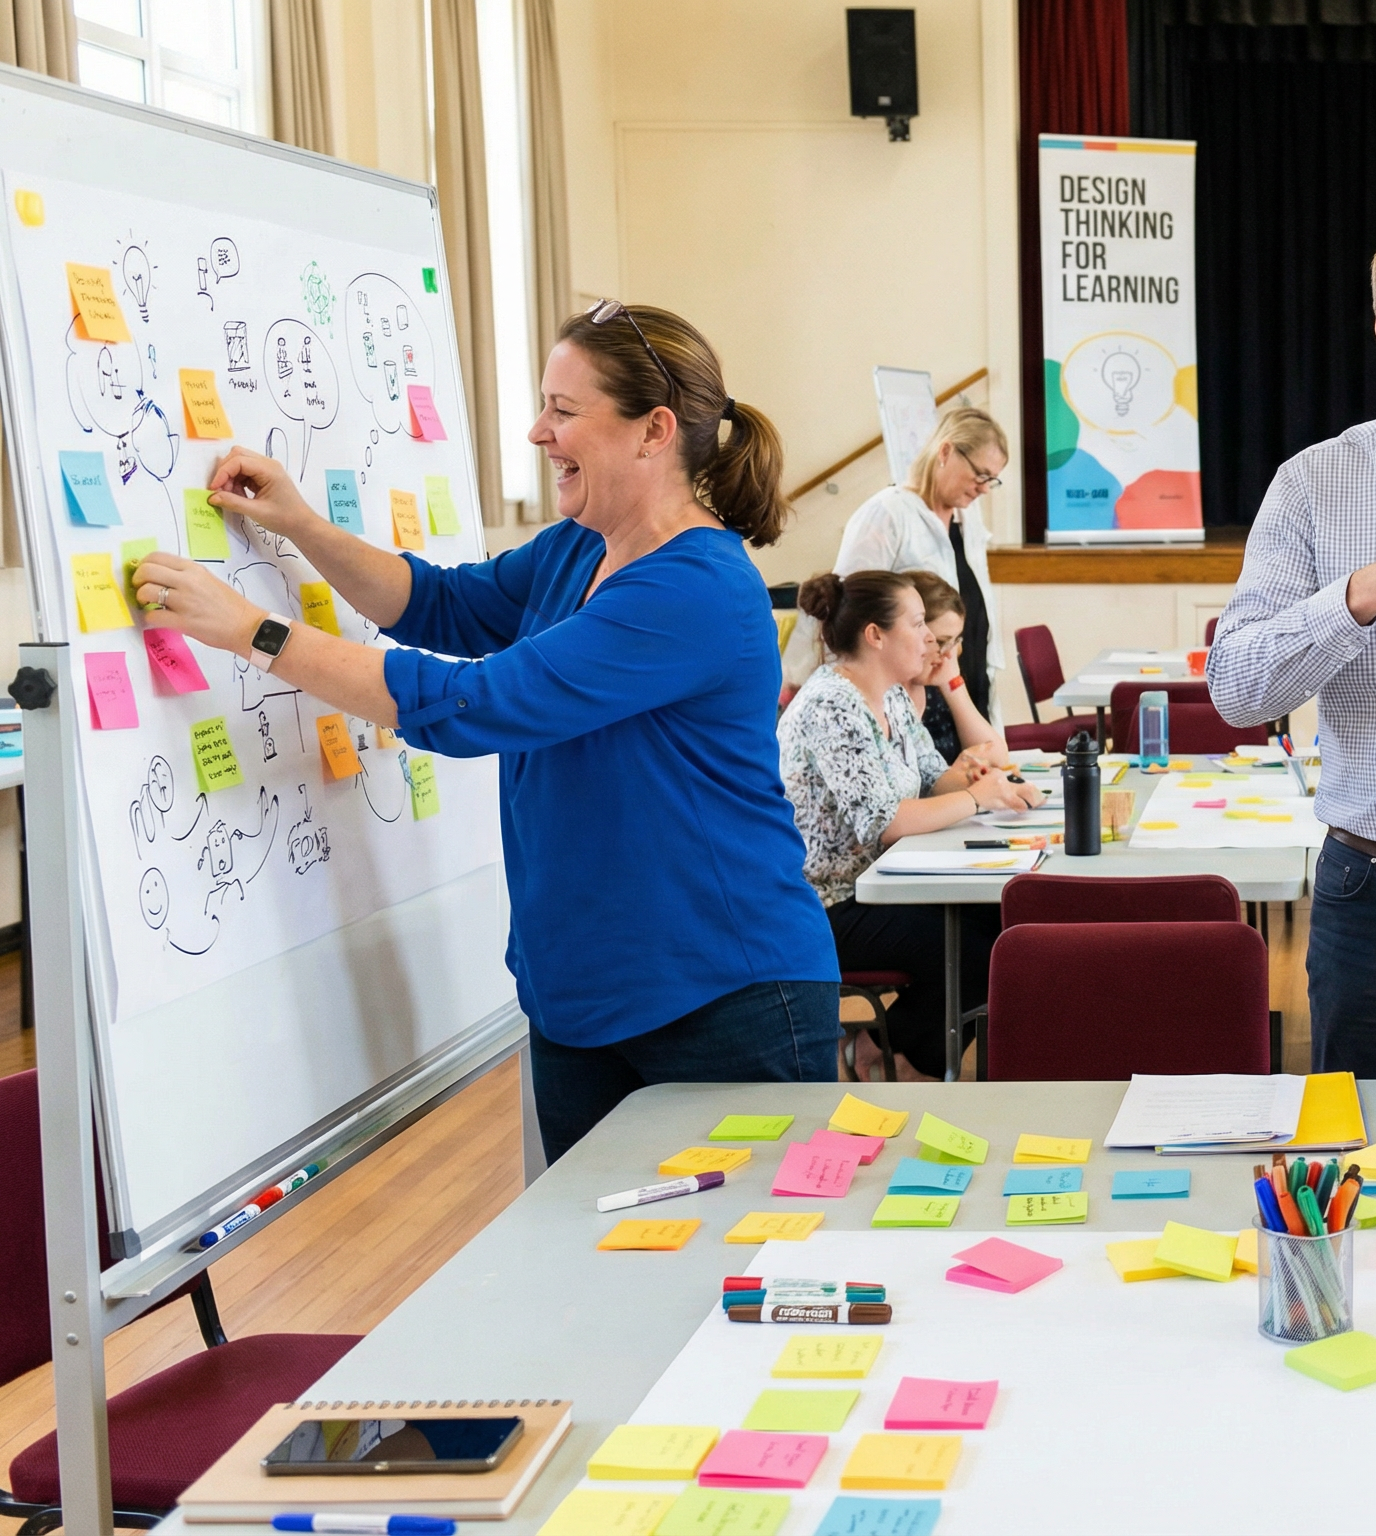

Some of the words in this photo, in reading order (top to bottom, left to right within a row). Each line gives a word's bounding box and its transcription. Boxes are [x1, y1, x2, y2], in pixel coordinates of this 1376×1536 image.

[1060, 175, 1146, 206] DESIGN
[1060, 208, 1174, 240] THINKING
[1061, 241, 1107, 270] FOR
[1062, 273, 1180, 304] LEARNING
